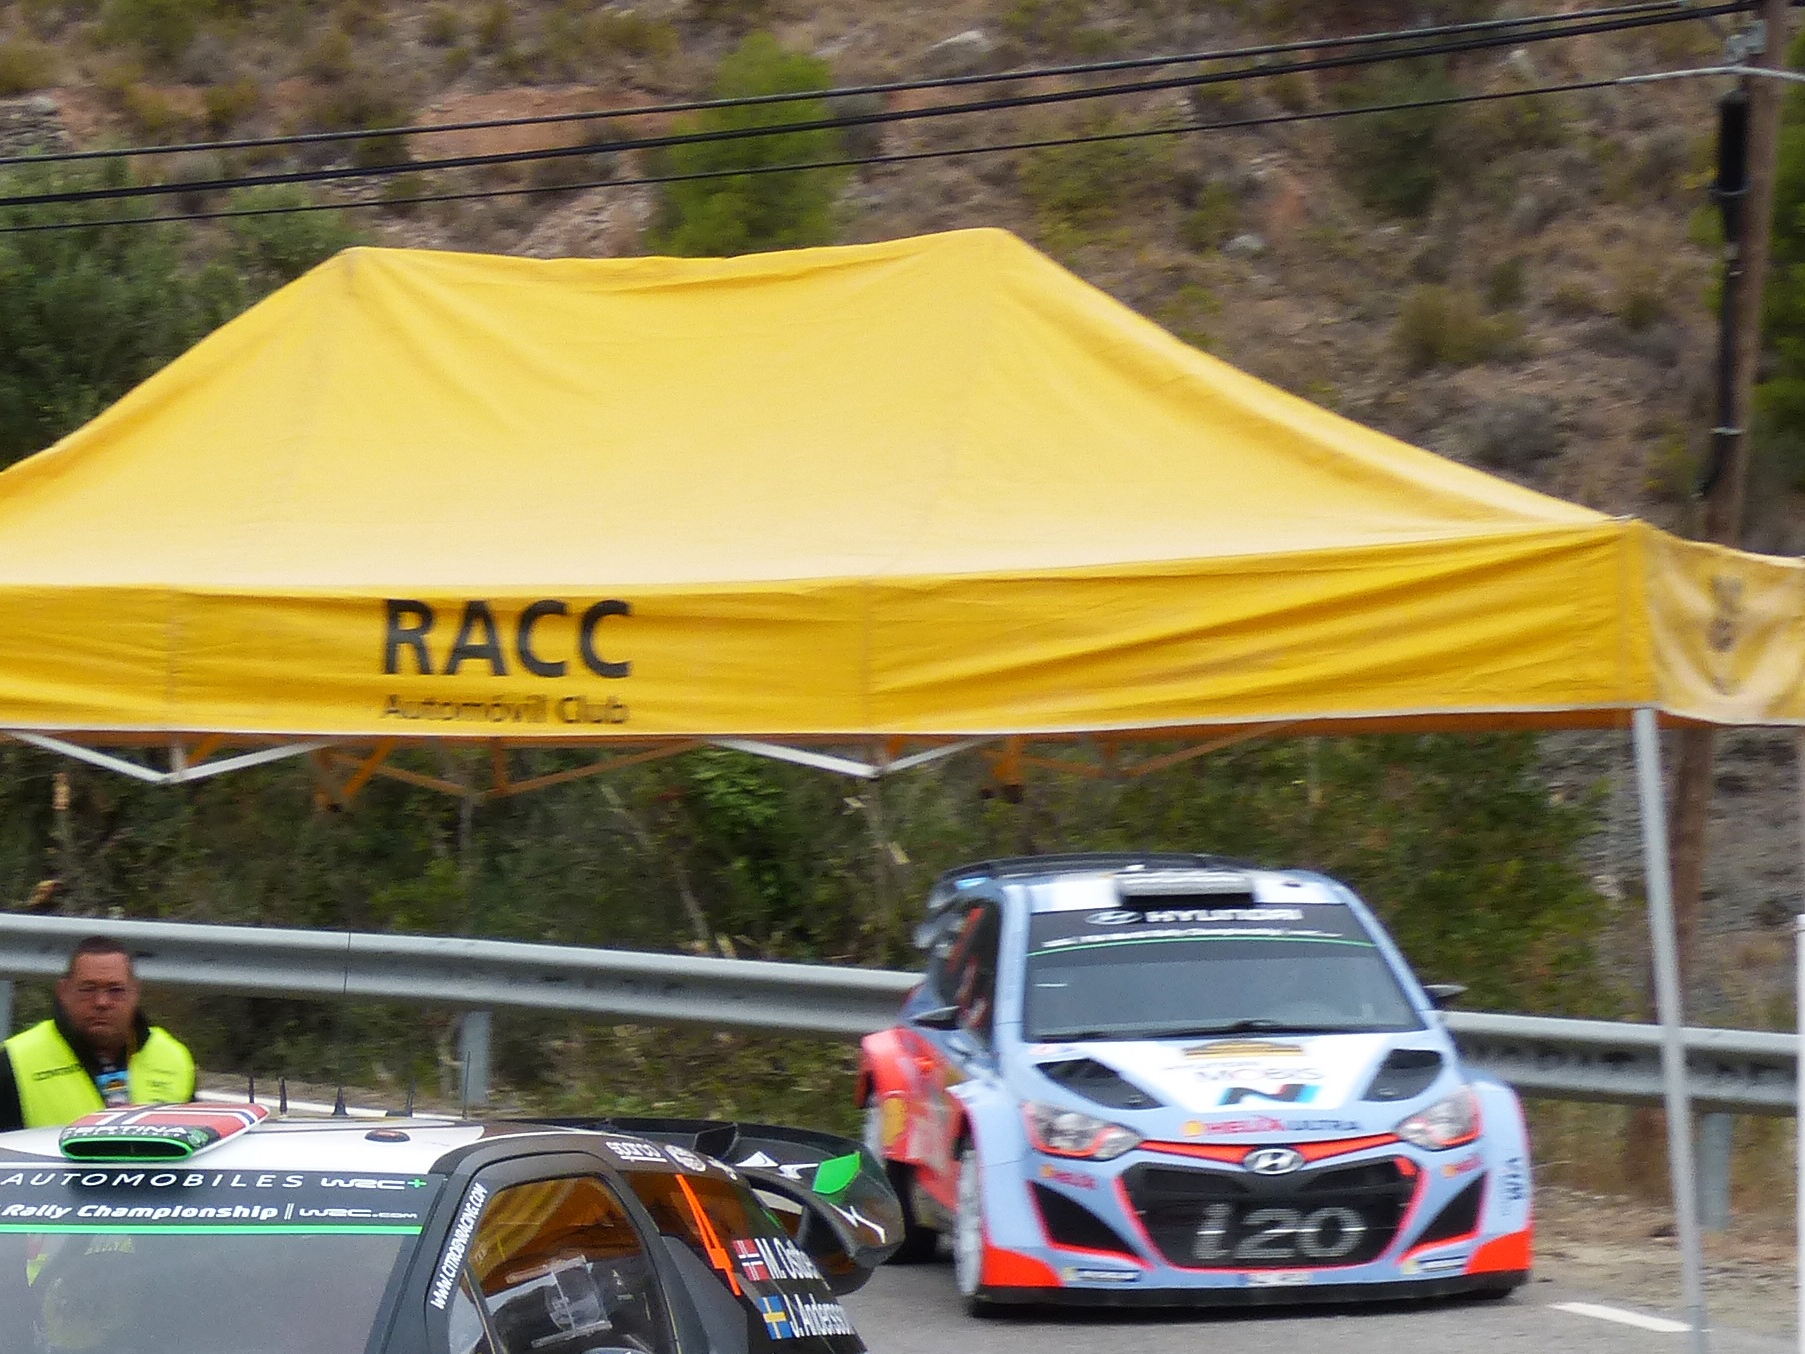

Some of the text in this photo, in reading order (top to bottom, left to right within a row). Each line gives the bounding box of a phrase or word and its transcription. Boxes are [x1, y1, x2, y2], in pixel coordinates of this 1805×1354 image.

[383, 599, 632, 677] RACC
[558, 694, 631, 724] Club
[0, 1172, 304, 1189] AUTOMOBILES
[1, 1203, 71, 1219] Rally
[77, 1204, 279, 1221] Championship
[1195, 1201, 1367, 1260] i20
